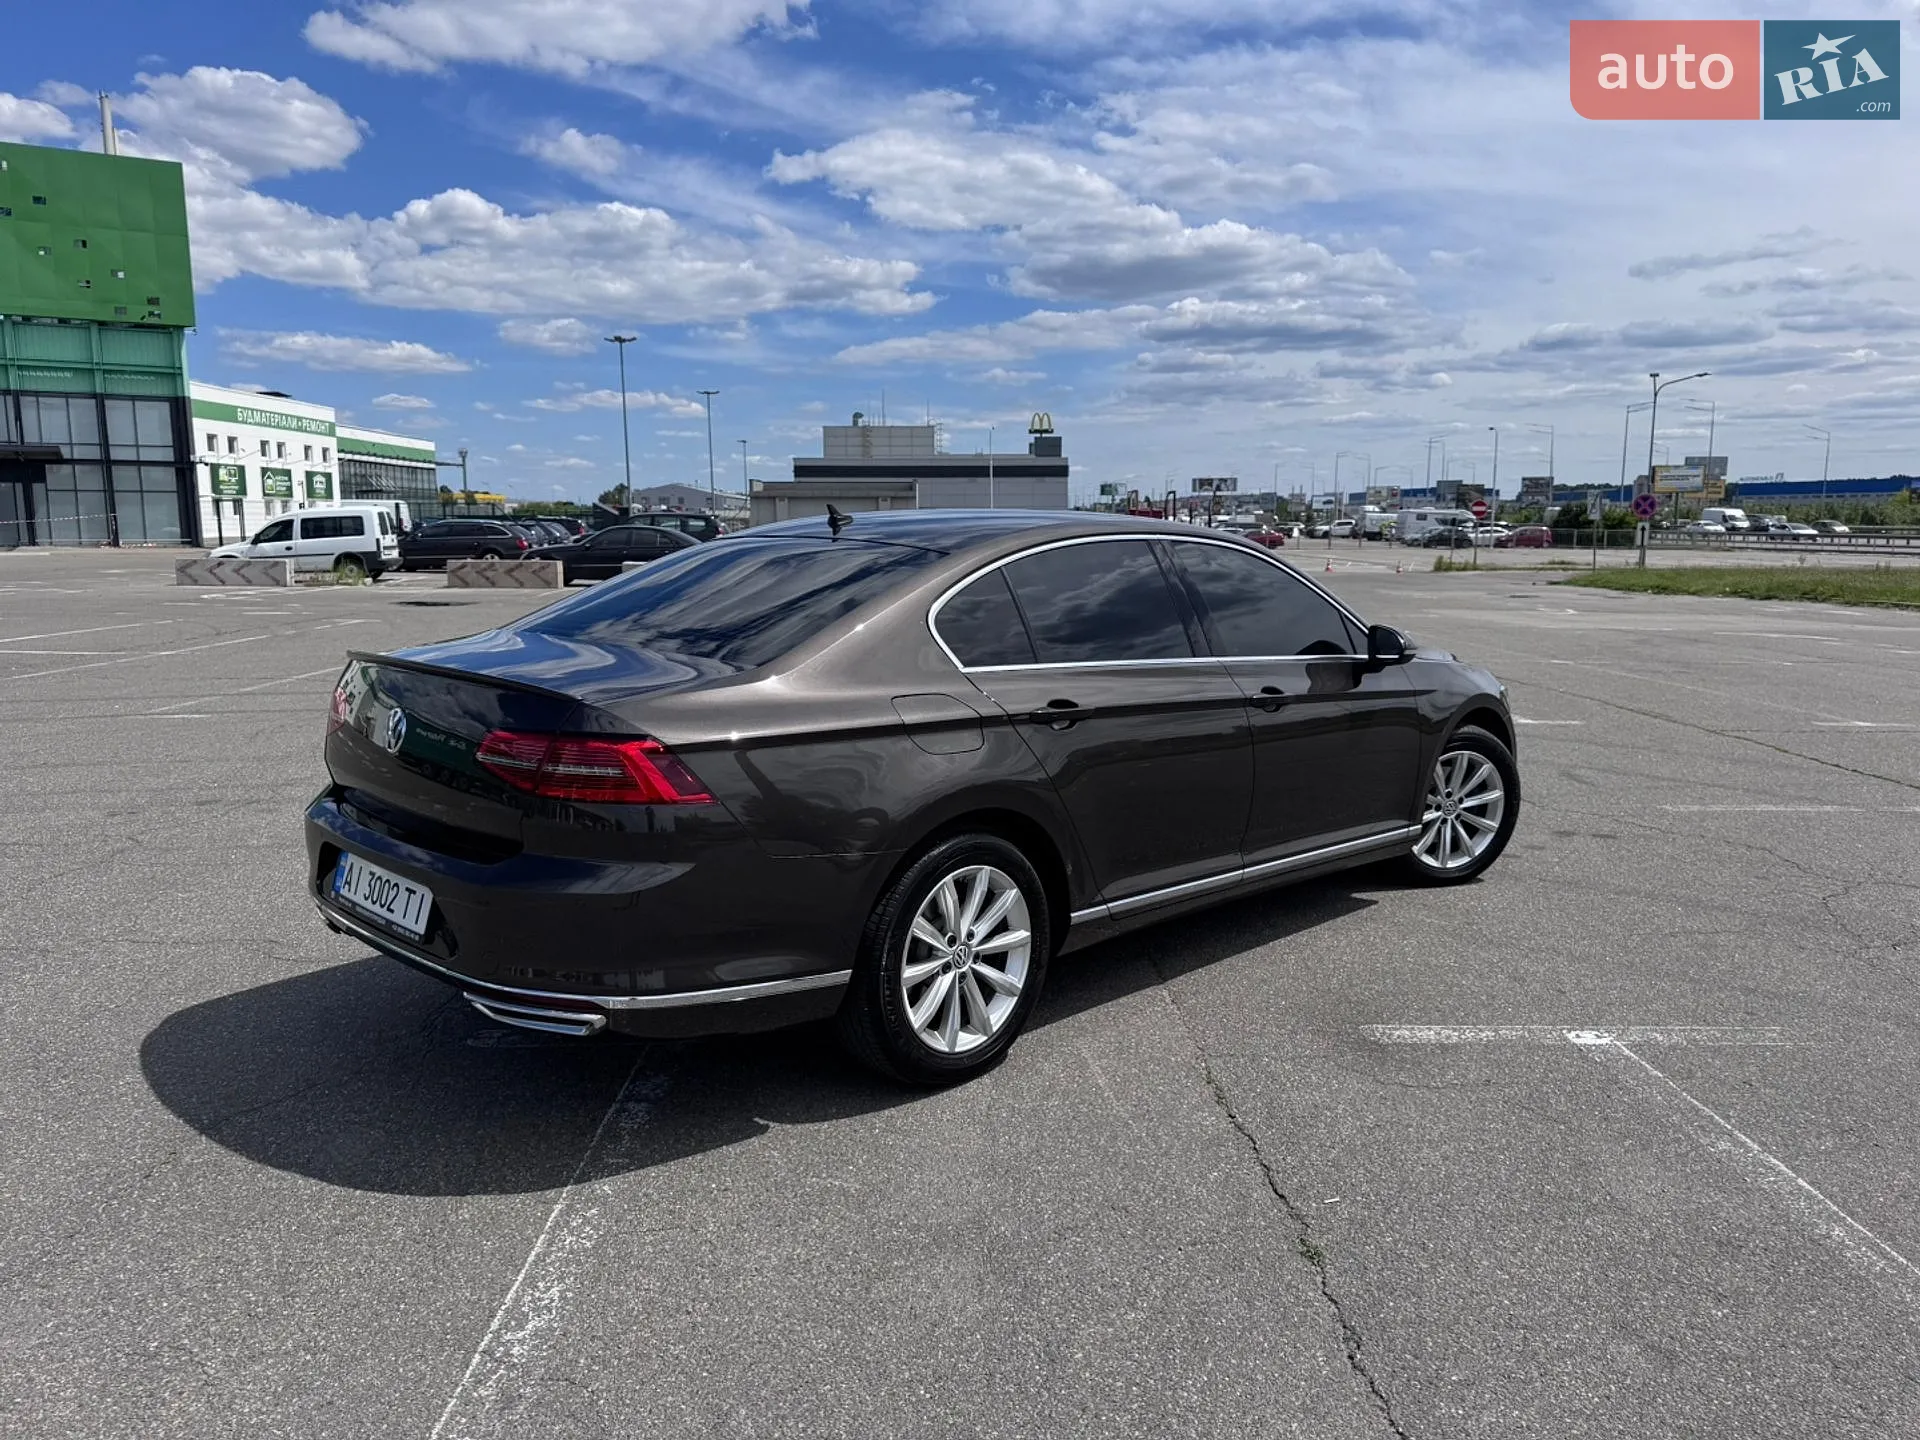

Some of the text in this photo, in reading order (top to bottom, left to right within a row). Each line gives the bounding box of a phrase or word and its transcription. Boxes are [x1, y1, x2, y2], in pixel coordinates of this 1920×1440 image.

[237, 408, 329, 434] БУДМАТЕРІАЛИ РЕМОНТ
[342, 861, 363, 896] AI
[363, 871, 400, 914] 3002
[402, 886, 425, 925] TI
